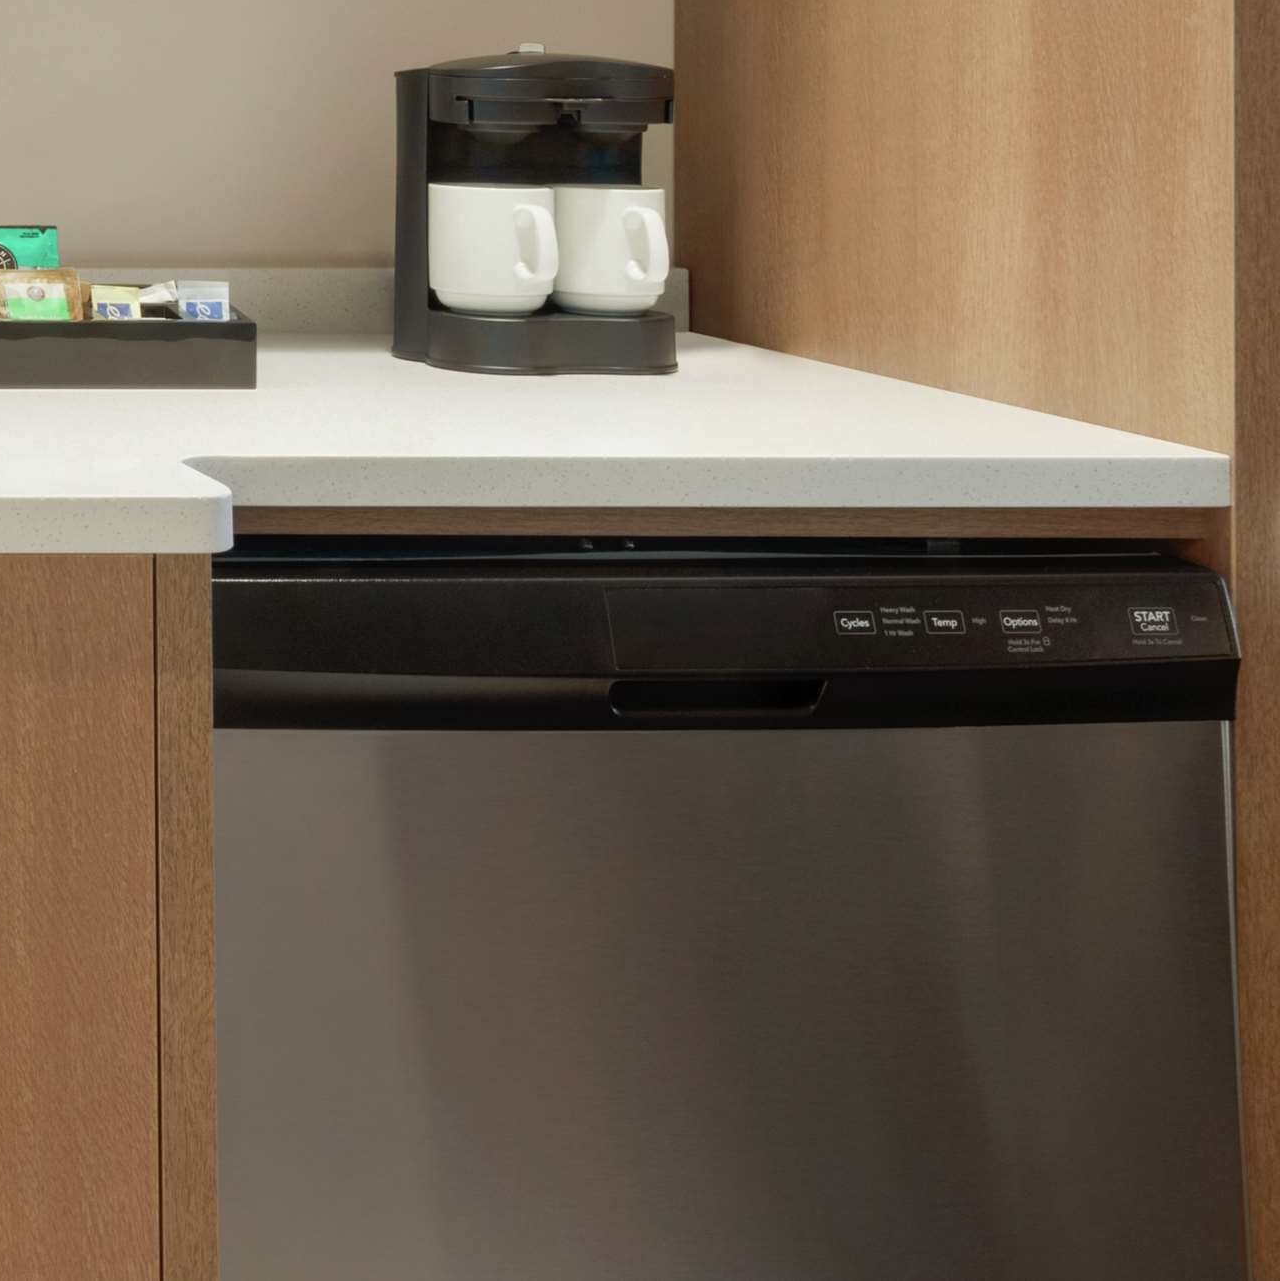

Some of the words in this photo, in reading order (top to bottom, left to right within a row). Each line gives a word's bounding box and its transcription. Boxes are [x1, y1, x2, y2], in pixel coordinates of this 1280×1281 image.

[1133, 611, 1170, 622] START
[840, 618, 871, 630] Cycles
[931, 617, 958, 630] Temp
[1003, 617, 1038, 629] Options
[1140, 623, 1169, 631] Cancel
